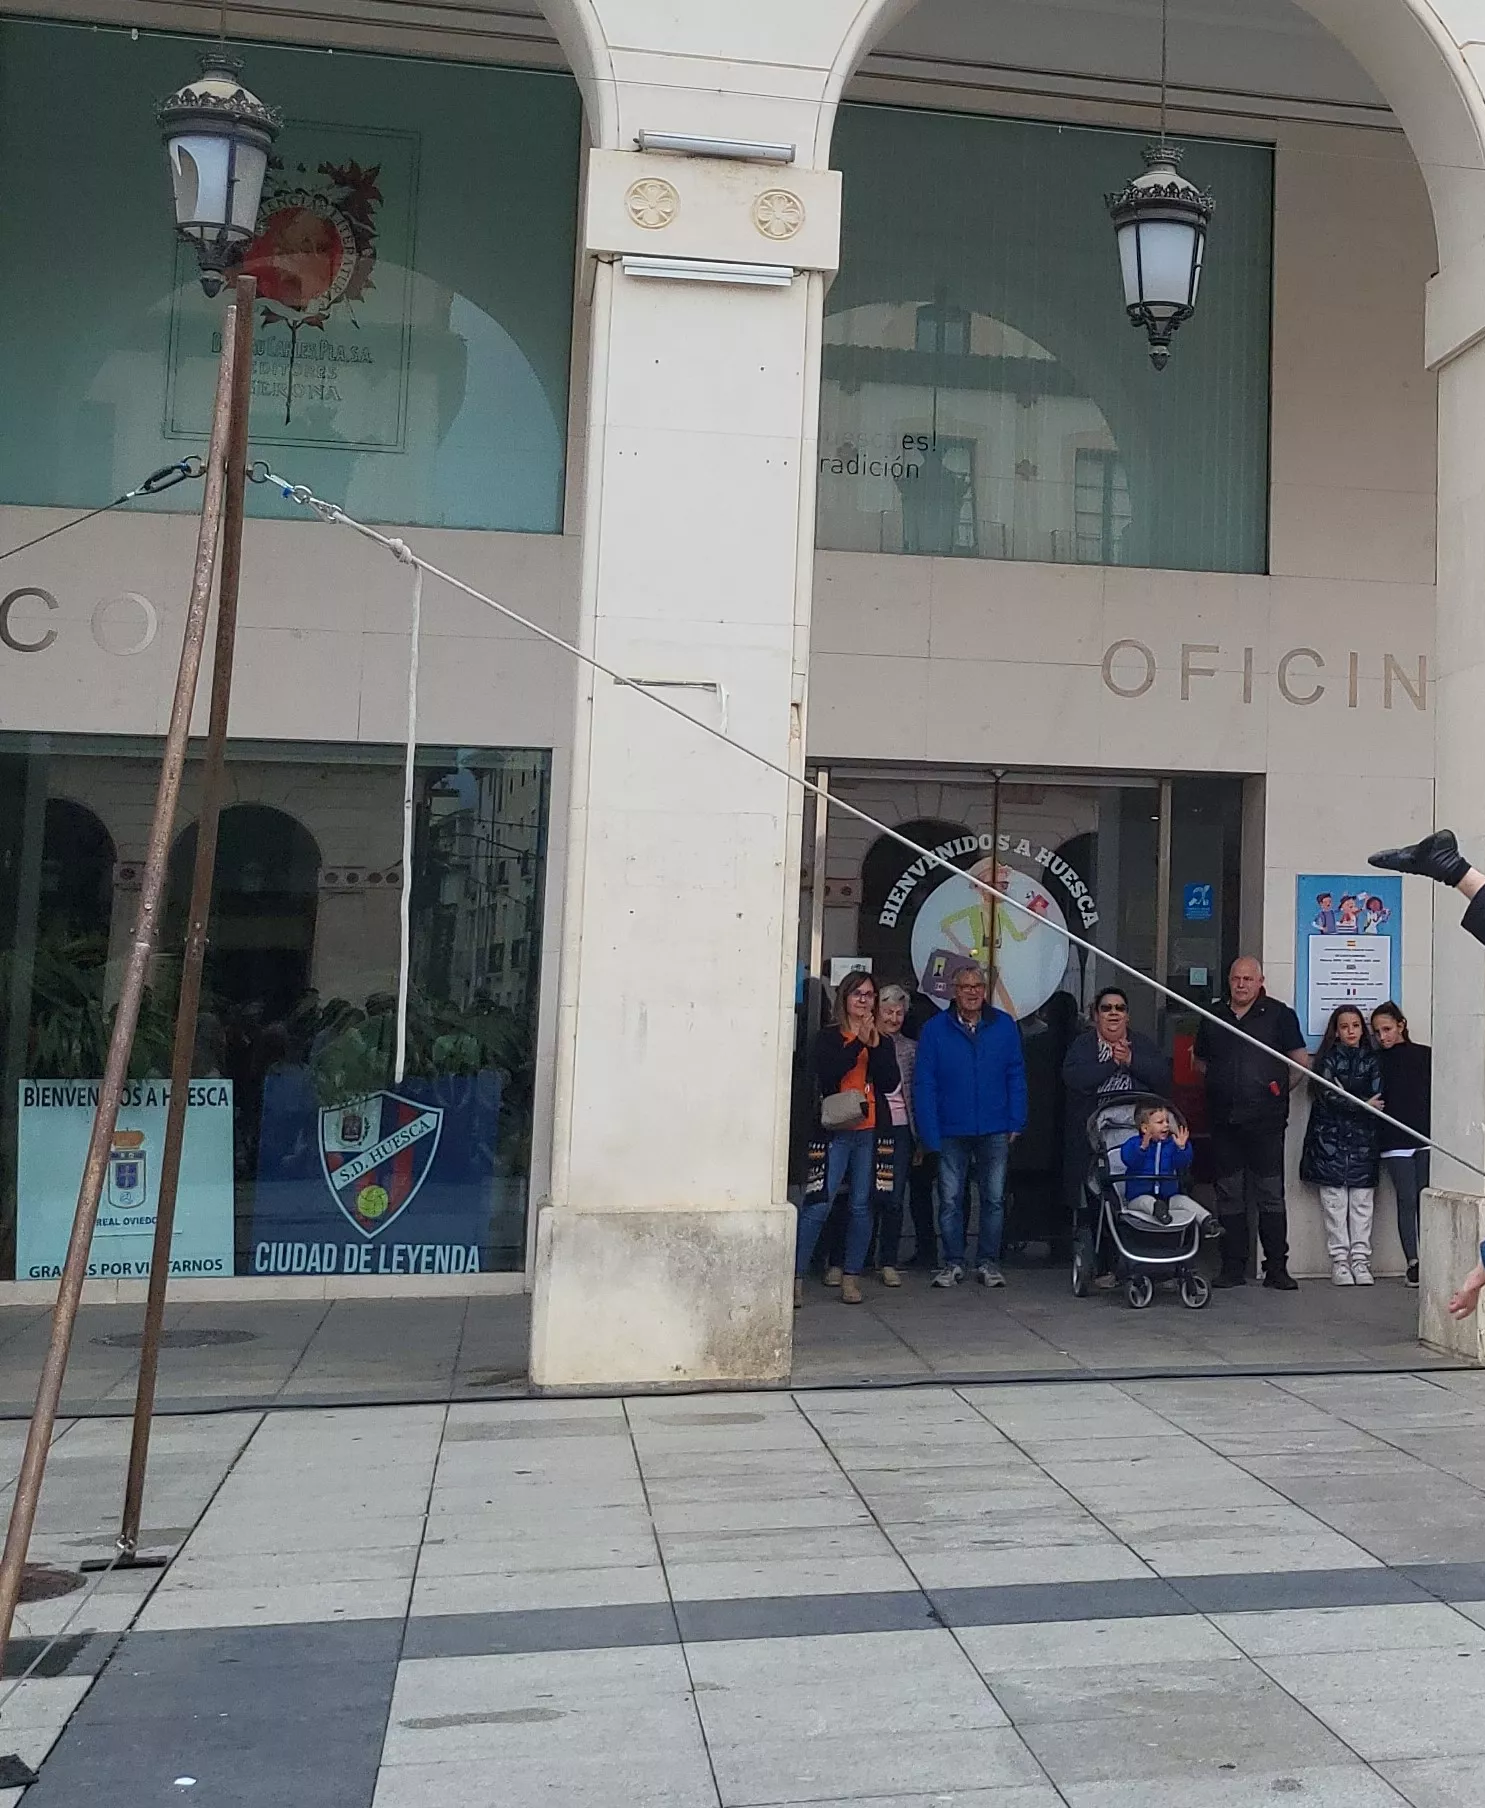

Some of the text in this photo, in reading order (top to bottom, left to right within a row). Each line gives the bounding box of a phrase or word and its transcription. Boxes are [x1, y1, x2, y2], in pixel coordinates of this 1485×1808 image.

[820, 454, 919, 479] radición
[1101, 639, 1427, 710] OFICIN
[879, 833, 1099, 930] BIENVENIDOS A HUESCA
[24, 1086, 141, 1107] BIENVENOS
[146, 1087, 157, 1106] A
[339, 1119, 431, 1183] S.D. HUESCA
[96, 1217, 120, 1227] REAL
[101, 1262, 132, 1276] POR
[255, 1242, 480, 1274] CIUDAD DE LEYENDA
